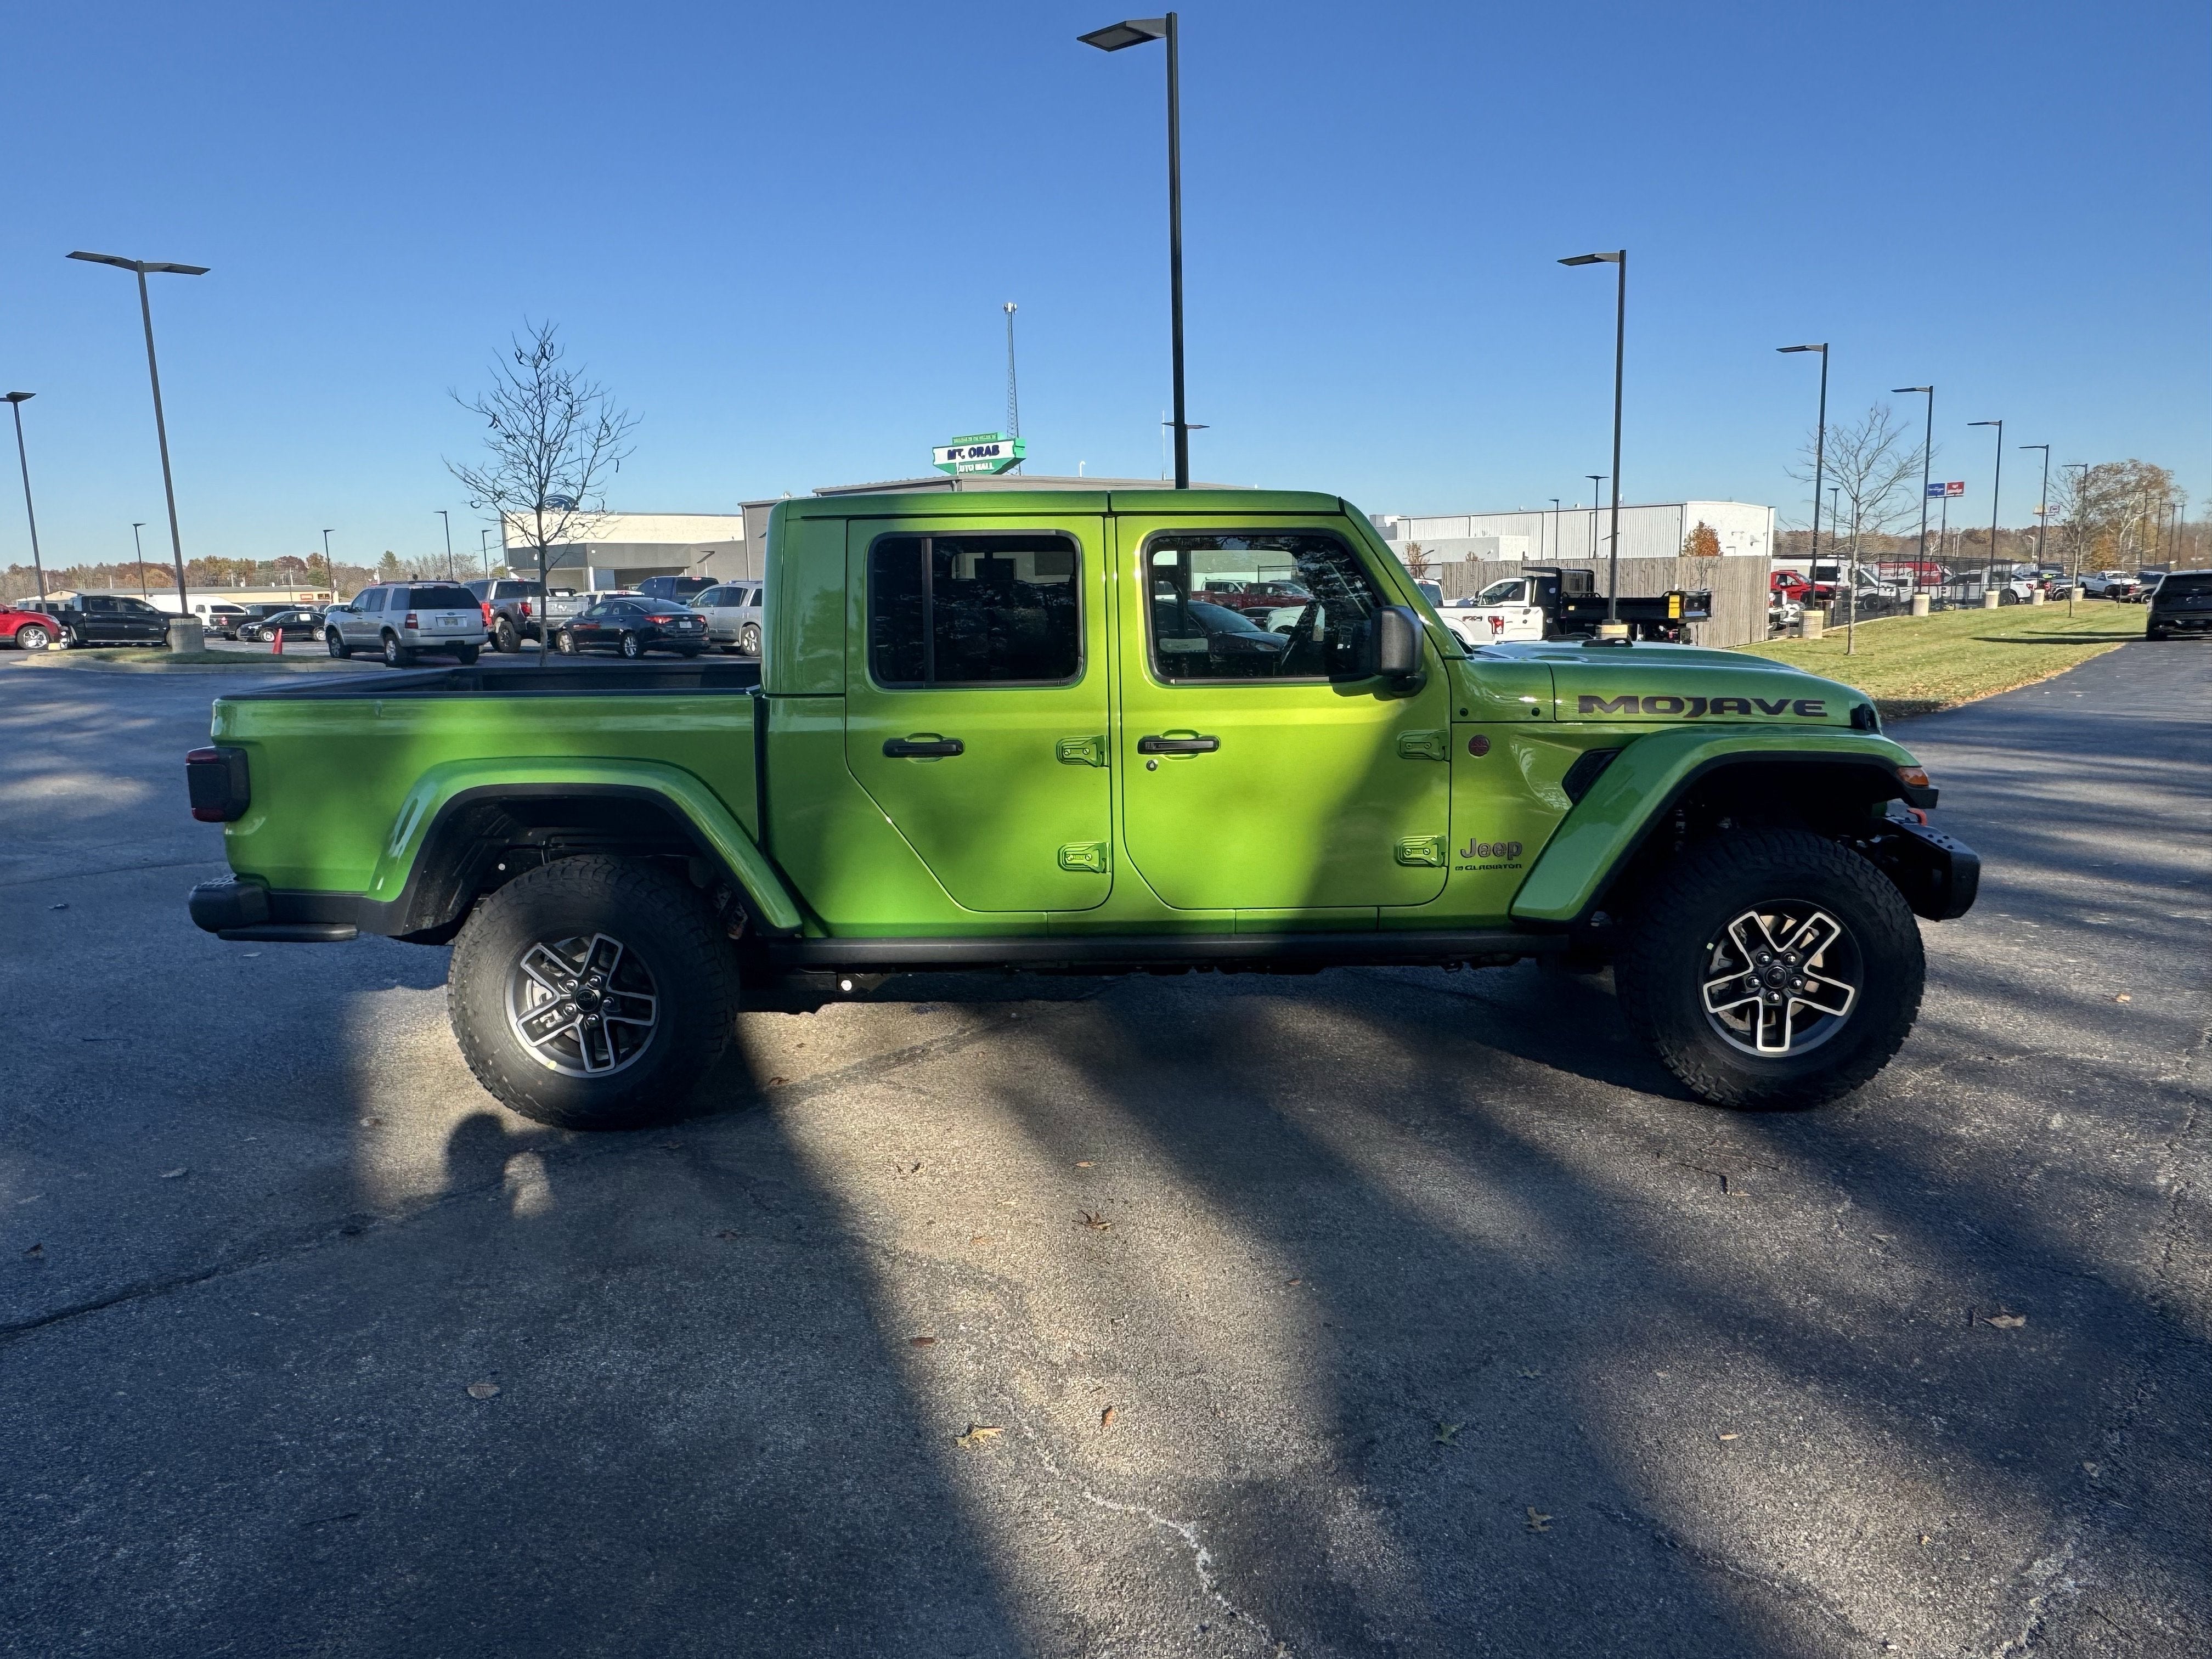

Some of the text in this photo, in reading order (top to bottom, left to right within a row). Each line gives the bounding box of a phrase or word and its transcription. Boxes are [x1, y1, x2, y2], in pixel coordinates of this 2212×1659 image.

[968, 445, 1000, 459] ORAB
[975, 462, 995, 471] MALL
[1578, 695, 1828, 718] MOJAVE
[1460, 838, 1523, 861] Jeep
